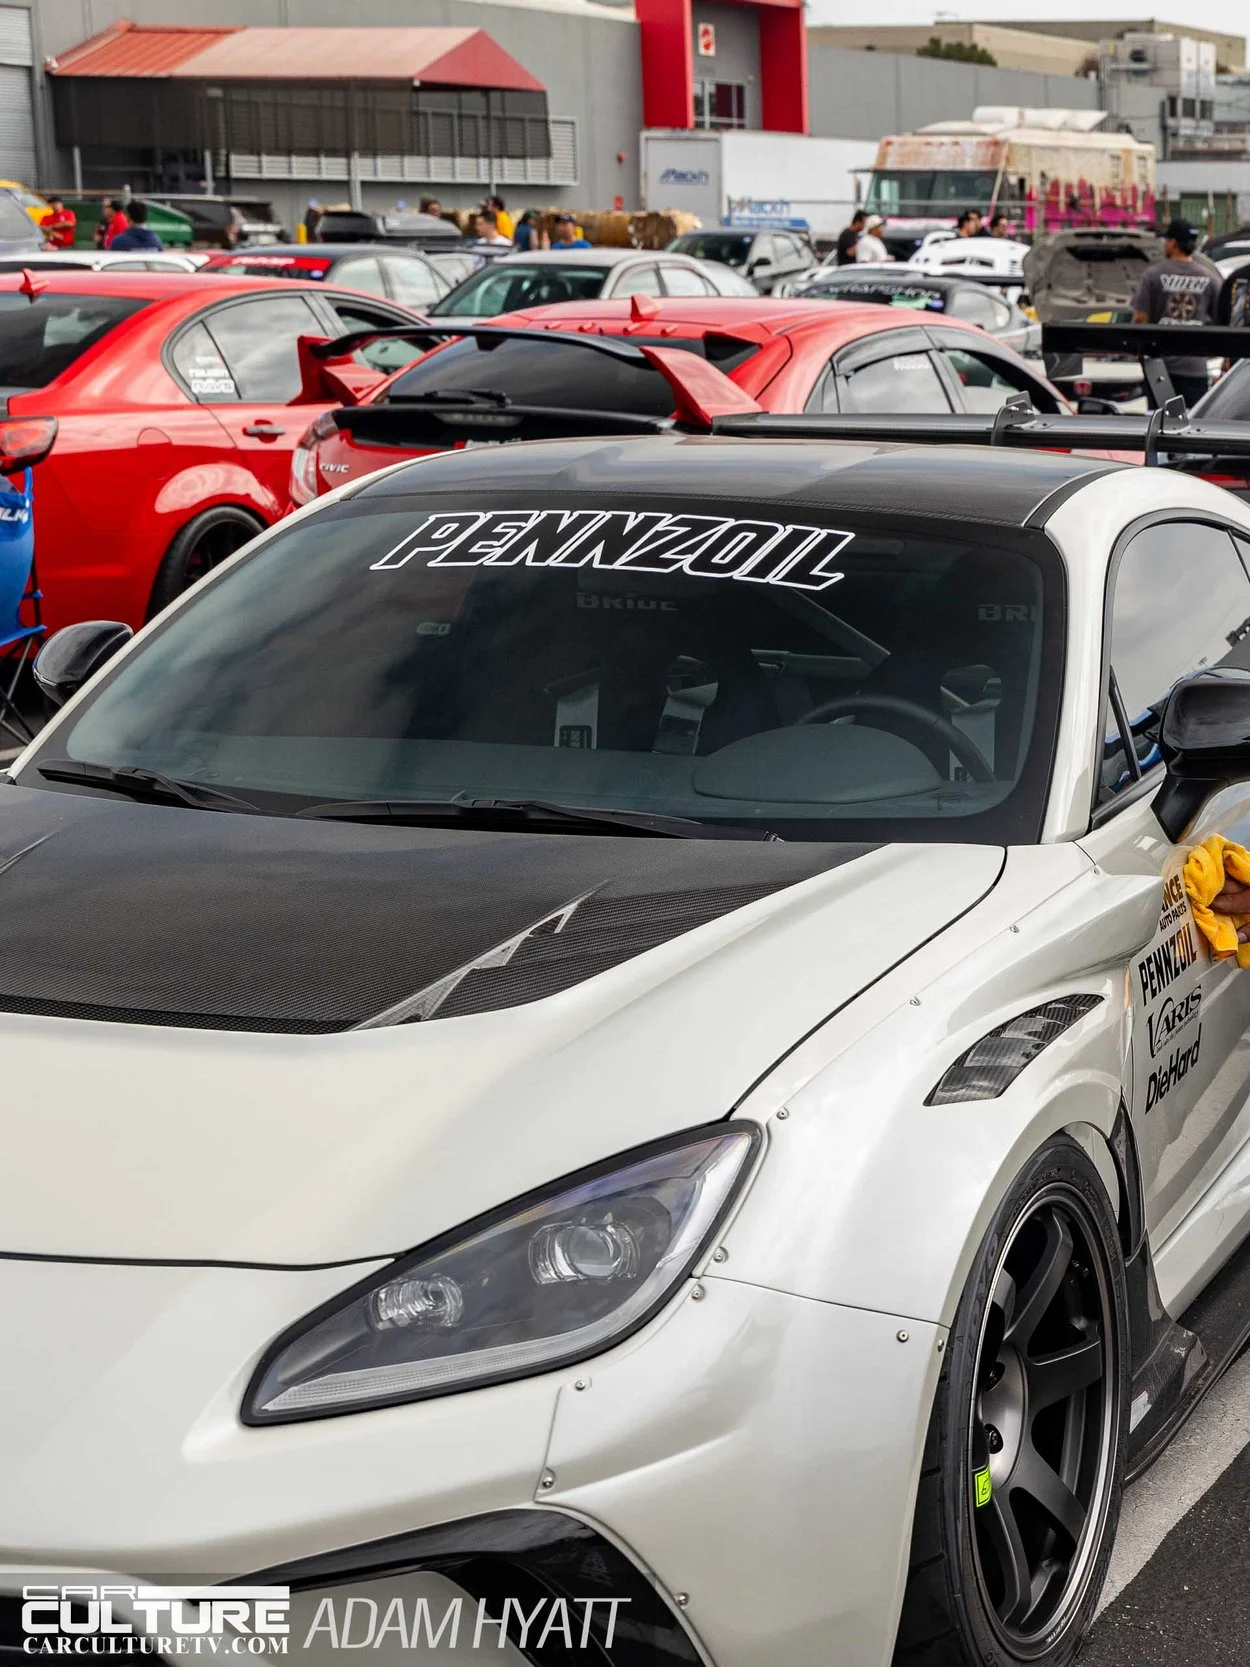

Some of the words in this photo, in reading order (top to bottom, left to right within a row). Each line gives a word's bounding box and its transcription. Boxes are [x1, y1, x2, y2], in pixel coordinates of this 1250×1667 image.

[369, 510, 856, 591] PENNZOIL
[1159, 912, 1173, 932] AUTO
[1138, 922, 1198, 1007] PENNZOIL
[1145, 1022, 1202, 1115] DieHard
